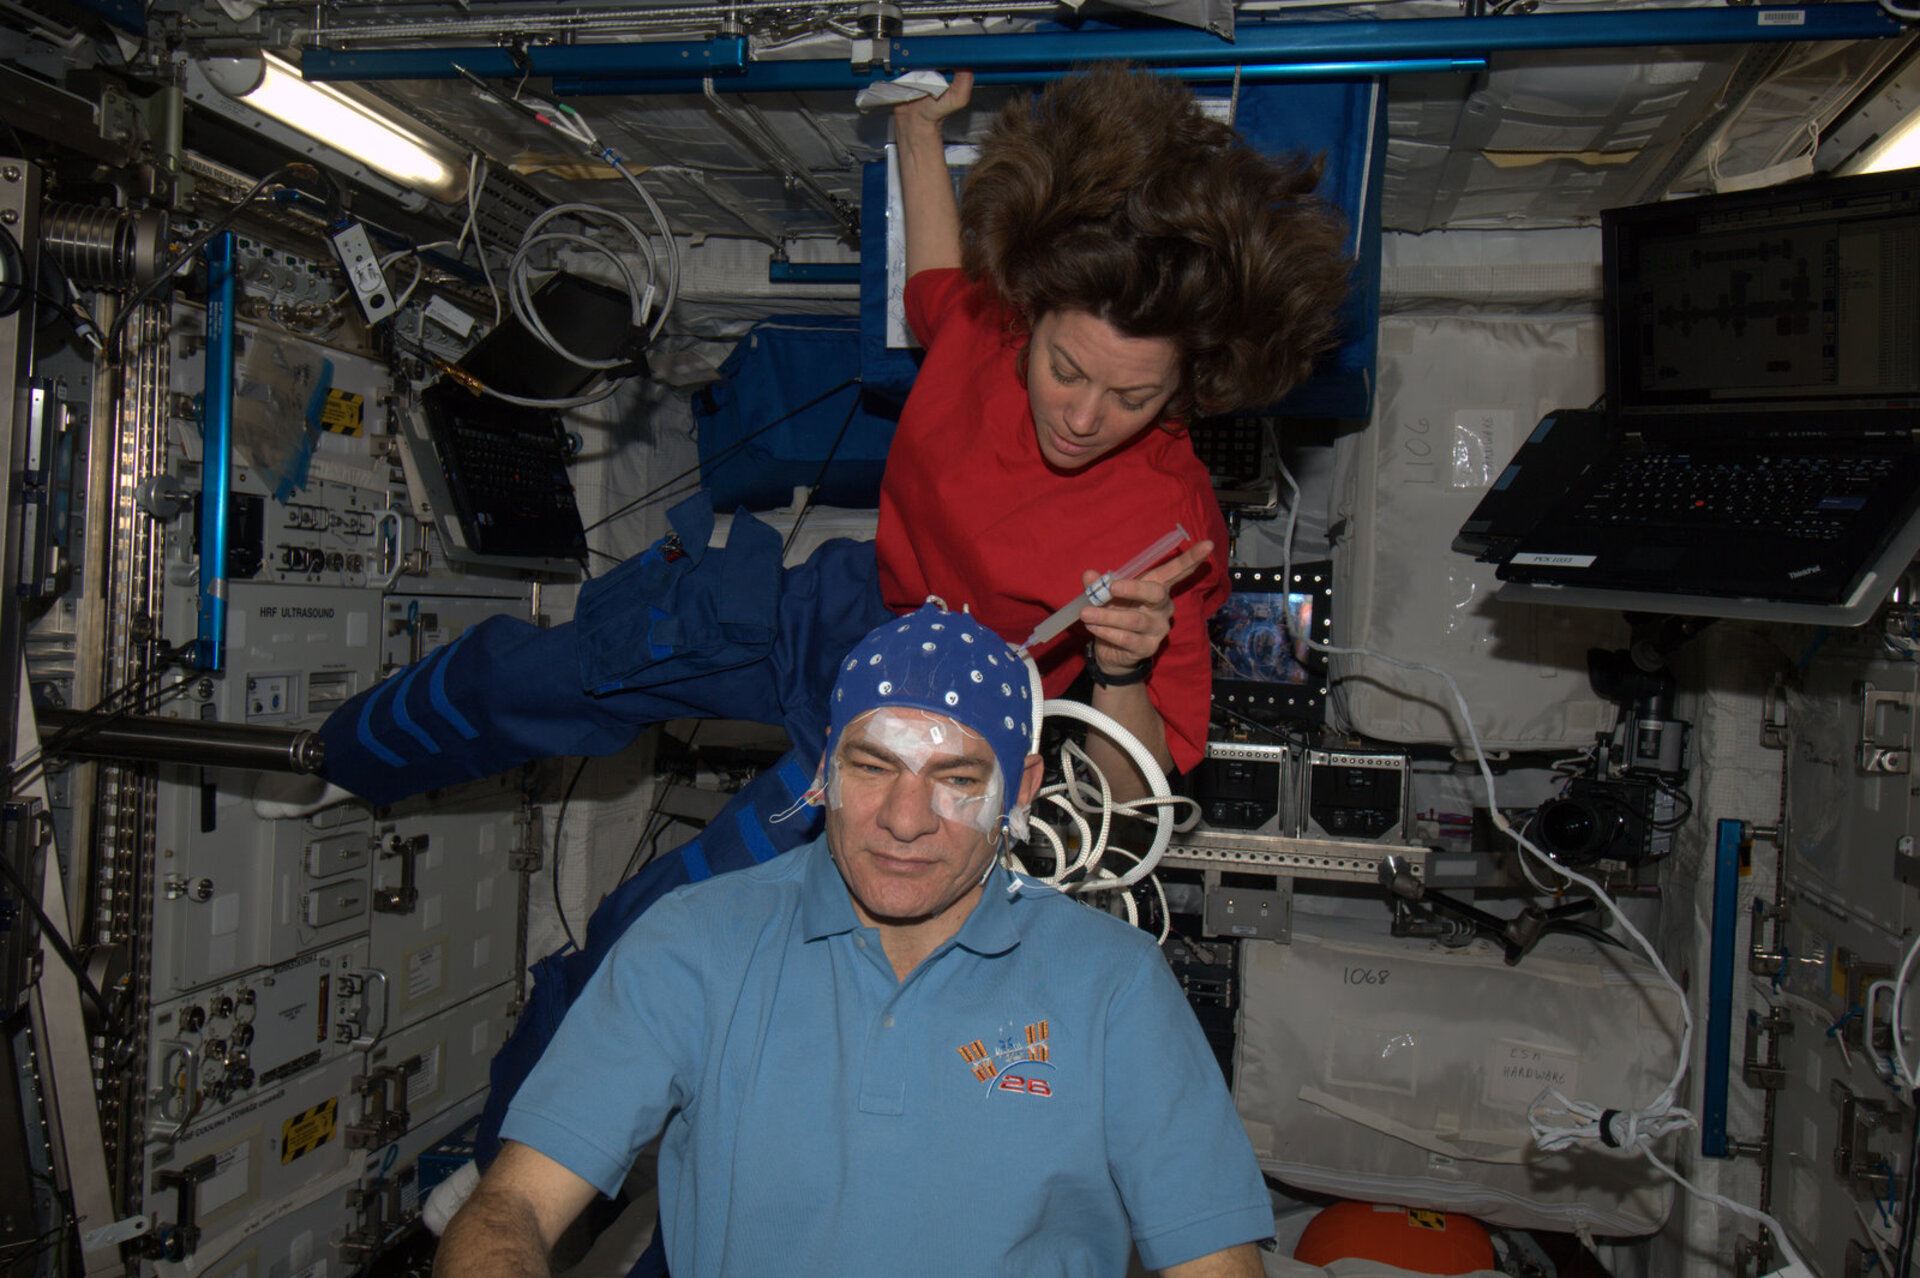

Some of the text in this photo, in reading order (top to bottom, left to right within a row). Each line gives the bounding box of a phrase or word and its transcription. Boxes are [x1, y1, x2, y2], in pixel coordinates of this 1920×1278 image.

[260, 607, 335, 618] HRF ULTRASOUND
[1344, 967, 1391, 985] 1068
[998, 1074, 1053, 1098] 26
